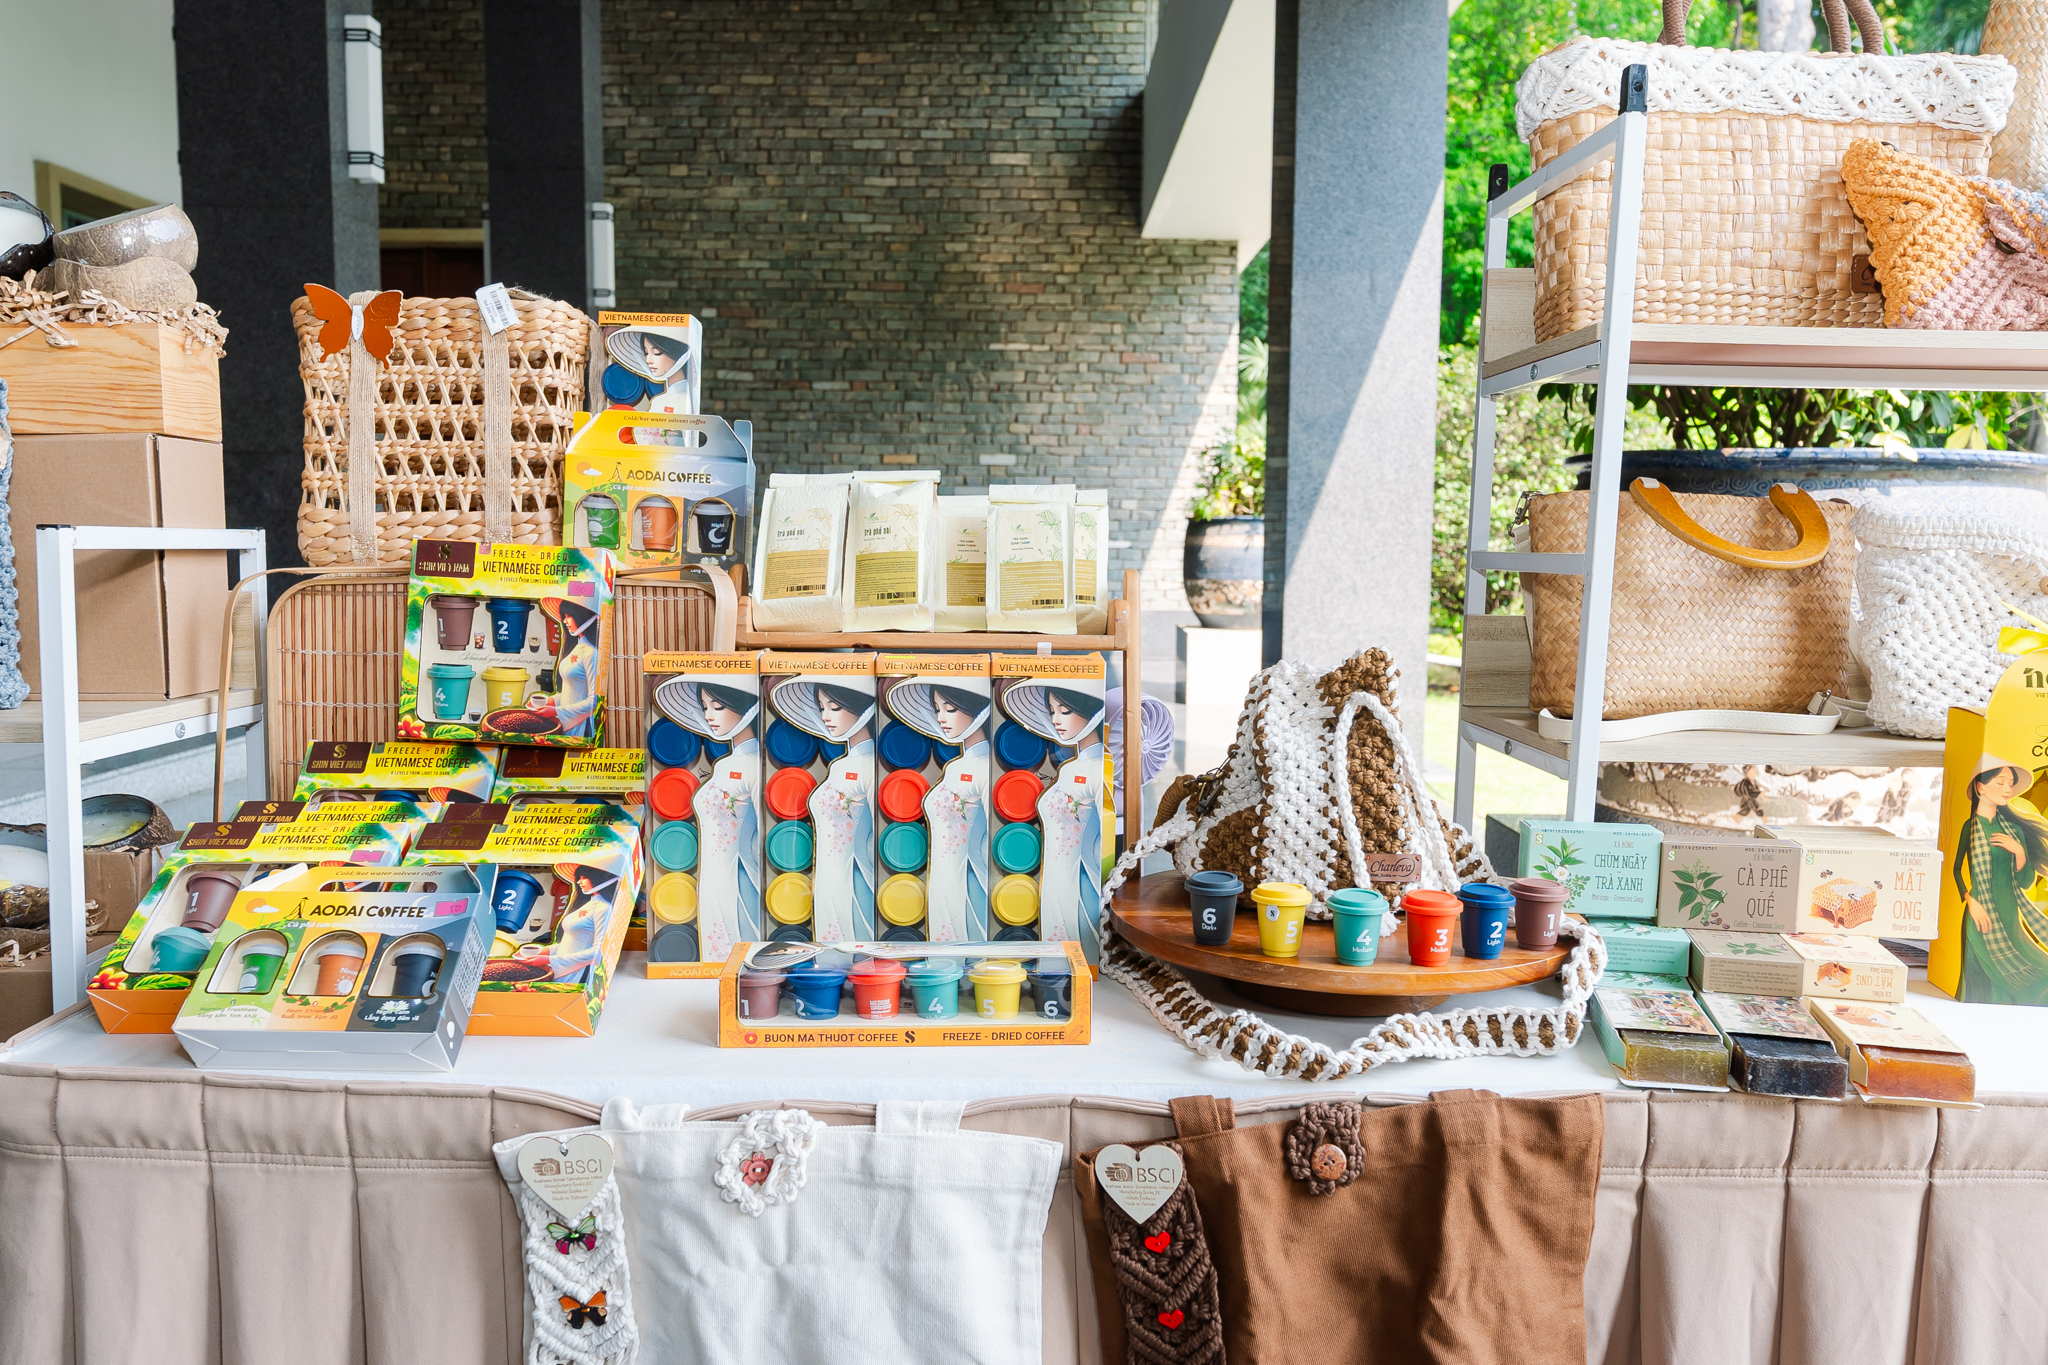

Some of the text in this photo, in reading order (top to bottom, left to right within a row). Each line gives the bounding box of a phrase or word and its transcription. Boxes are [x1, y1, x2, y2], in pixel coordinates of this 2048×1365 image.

[604, 314, 685, 323] VIETNAMESE COFFEE
[624, 415, 645, 423] Cold/hot
[690, 418, 707, 426] coffee
[627, 470, 712, 484] AODAI COFFEE
[493, 549, 569, 562] FREEZE DRIED
[482, 561, 579, 578] VIETNAMESE COFFEE
[438, 617, 444, 633] 1
[497, 620, 509, 635] 2
[650, 659, 752, 669] VIETNAMESE COFFEE
[766, 659, 868, 670] VIETNAMESE COFFEE
[883, 662, 984, 672] VIETNAMESE COFFEE
[999, 663, 1099, 675] VIETNAMESE COFFEE
[435, 687, 446, 702] 4
[501, 692, 512, 706] 5
[434, 747, 462, 755] DRIED
[311, 760, 329, 769] SHIN
[329, 760, 345, 769] VIET
[375, 757, 471, 769] VIETNAMESE COFFEE
[570, 762, 628, 772] VIETNAMESE
[253, 815, 272, 823] VIET
[306, 813, 408, 823] VIETNAMESE COFFEE
[513, 815, 576, 825] VIETNAMESE
[577, 815, 615, 826] COFFEE
[563, 828, 596, 836] DRIED
[186, 838, 248, 847] SHIN VIET NAM
[261, 834, 375, 845] VIETNAMESE COFFEE
[494, 836, 605, 848] VIETNAMESE COFFEE
[1613, 840, 1634, 849] XÀ BÔNG
[1594, 851, 1648, 870] CHÙM NGÂY
[1753, 854, 1775, 862] XÀ BÔNG
[1900, 858, 1923, 867] XÀ BÔNG
[1595, 874, 1643, 891] TRÀ XANH
[1737, 863, 1788, 888] CÀ PHÊ
[1894, 867, 1926, 894] MẬT
[190, 891, 199, 907] 1
[502, 889, 517, 906] 2
[310, 904, 427, 918] AODAI COFFEE
[1747, 891, 1775, 919] QUẾ
[1893, 900, 1922, 921] ONG
[1202, 907, 1217, 925] 6
[1547, 913, 1555, 930] 1
[299, 920, 317, 930] phê
[1286, 920, 1299, 938] 5
[1490, 921, 1503, 939] 2
[1733, 920, 1748, 928] Coffee
[1892, 923, 1921, 933] Honey Soap
[1356, 929, 1373, 946] 4
[1434, 928, 1449, 946] 3
[669, 968, 702, 977] AODAI
[1856, 974, 1894, 990] MẬT ONG
[741, 999, 750, 1016] 1
[795, 998, 806, 1016] 2
[928, 997, 944, 1014] 4
[983, 999, 995, 1016] 5
[1044, 1000, 1059, 1016] 6
[764, 1033, 898, 1044] BUON MA THUOT COFFEE
[943, 1031, 1065, 1042] FREEZE DRIED COFFEE
[564, 1158, 603, 1175] BSCI
[1136, 1167, 1175, 1183] BSCI
